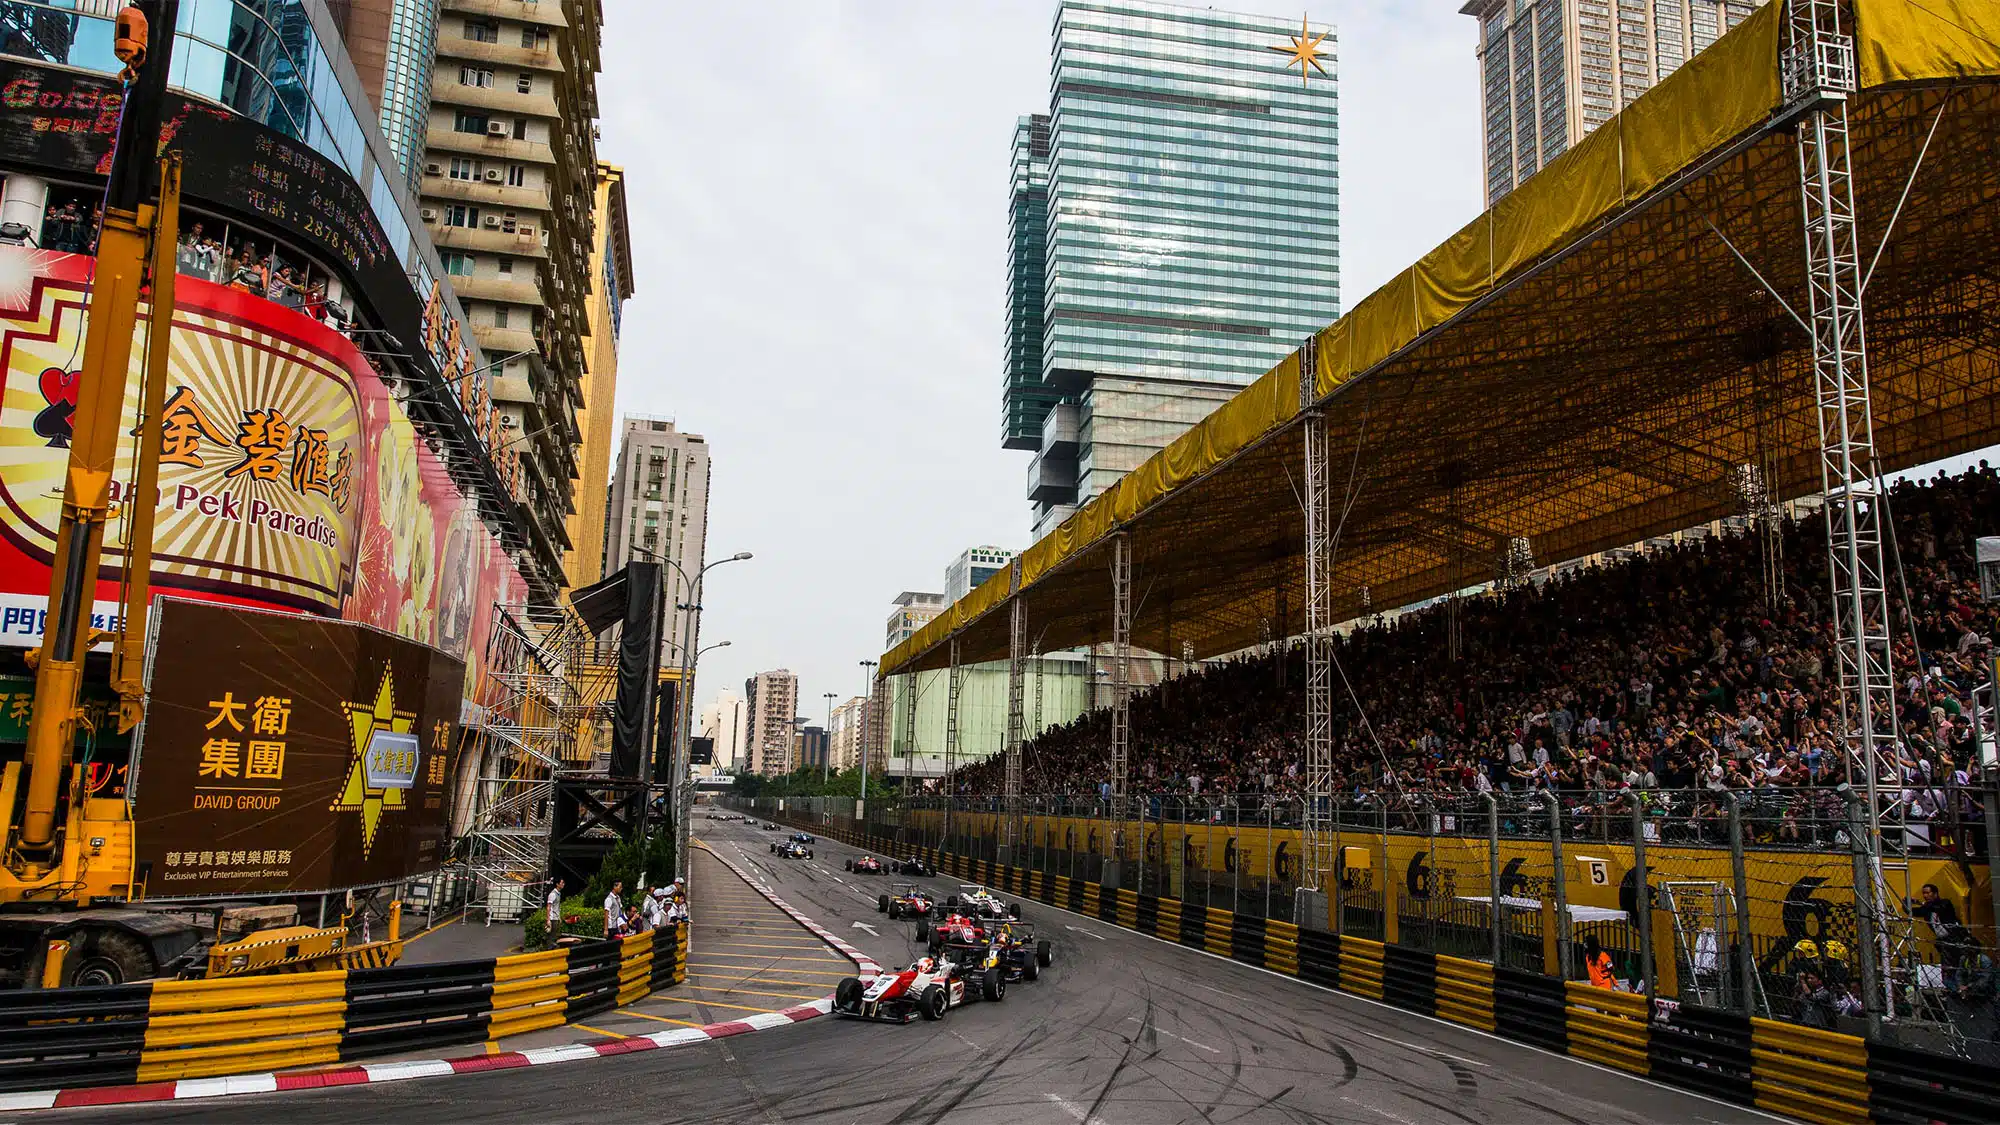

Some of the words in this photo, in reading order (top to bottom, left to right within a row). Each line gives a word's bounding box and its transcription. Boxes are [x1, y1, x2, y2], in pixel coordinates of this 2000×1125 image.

[176, 484, 241, 521] Pek
[250, 503, 336, 548] Paradise
[205, 691, 291, 735] 大衛
[199, 738, 286, 780] 集團
[194, 795, 233, 809] DAVID
[237, 796, 280, 810] GROUP
[165, 850, 292, 867] 尊享貴賓娛樂服務
[164, 872, 197, 880] Exclusive
[199, 871, 212, 879] VIP
[212, 870, 261, 878] Entertainment
[262, 869, 289, 877] Services
[1591, 863, 1606, 884] 5
